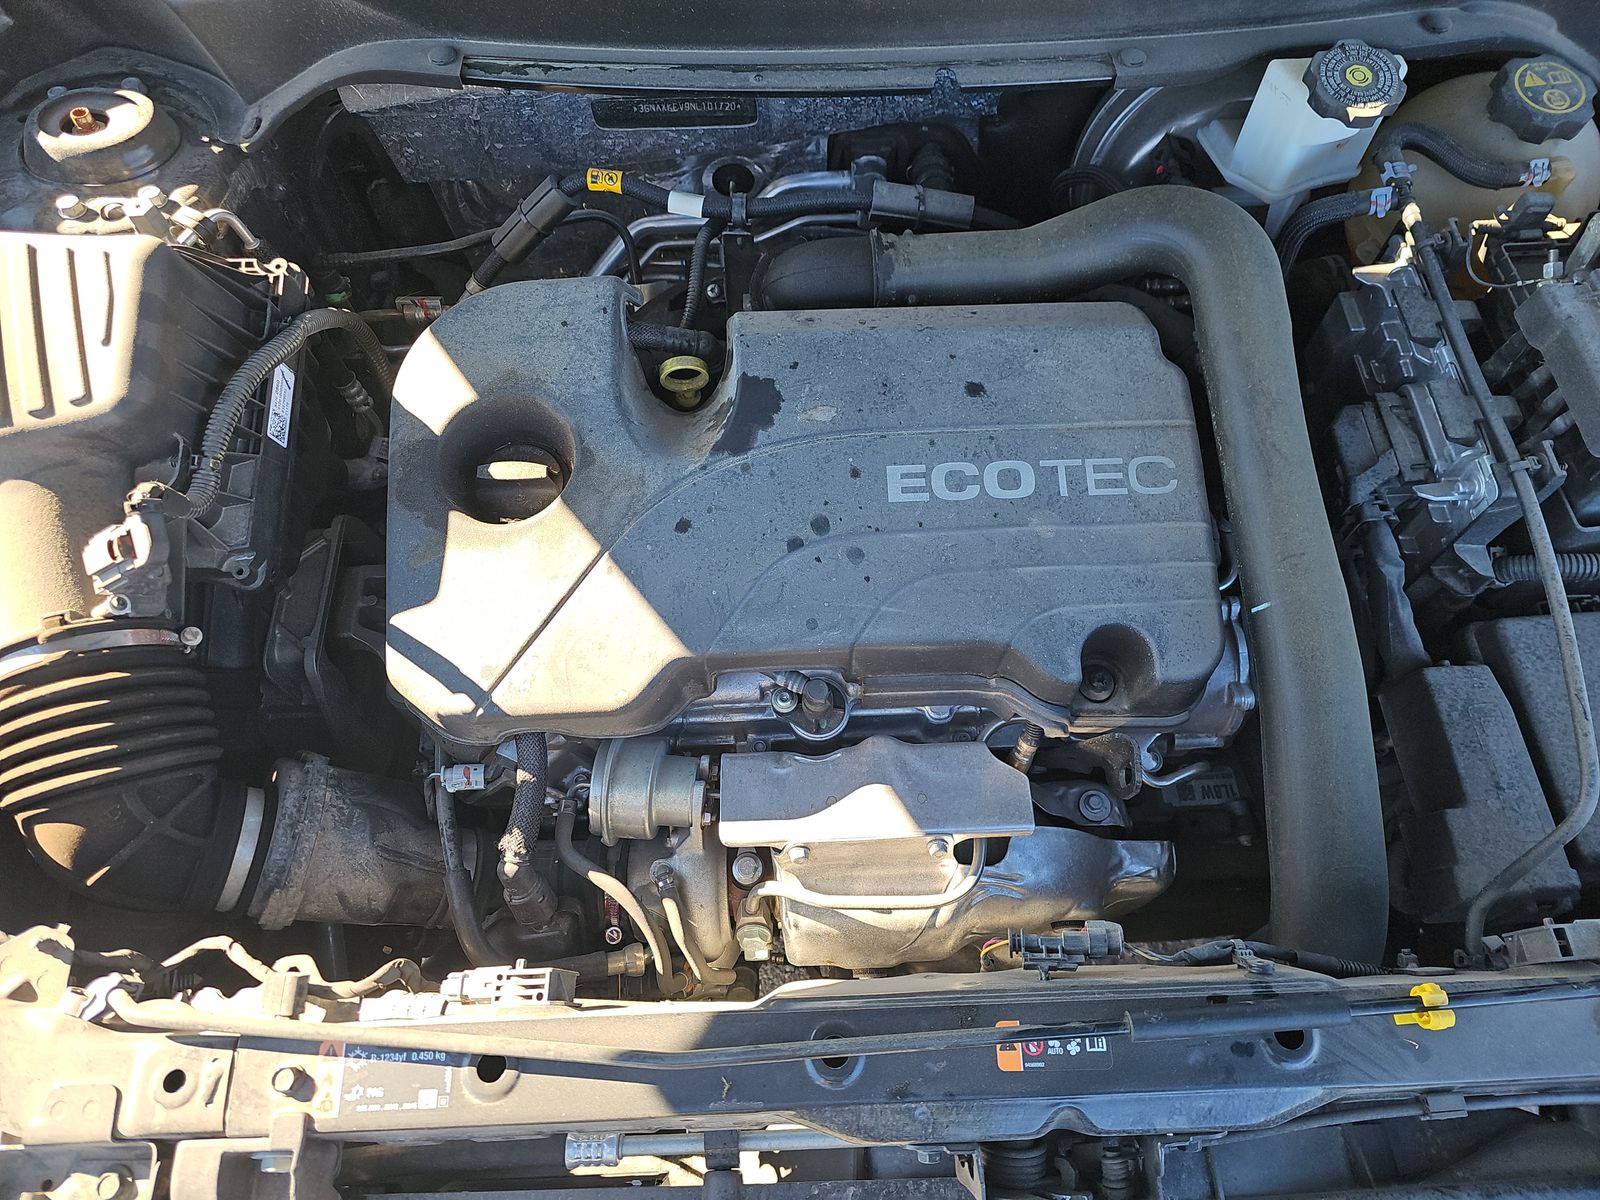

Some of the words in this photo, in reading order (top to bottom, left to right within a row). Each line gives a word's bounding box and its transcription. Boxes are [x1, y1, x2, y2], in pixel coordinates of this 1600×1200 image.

[886, 455, 1178, 503] ECOTEC
[411, 1051, 434, 1061] 0.450
[435, 1051, 446, 1061] kg
[1047, 1047, 1064, 1055] AUTO
